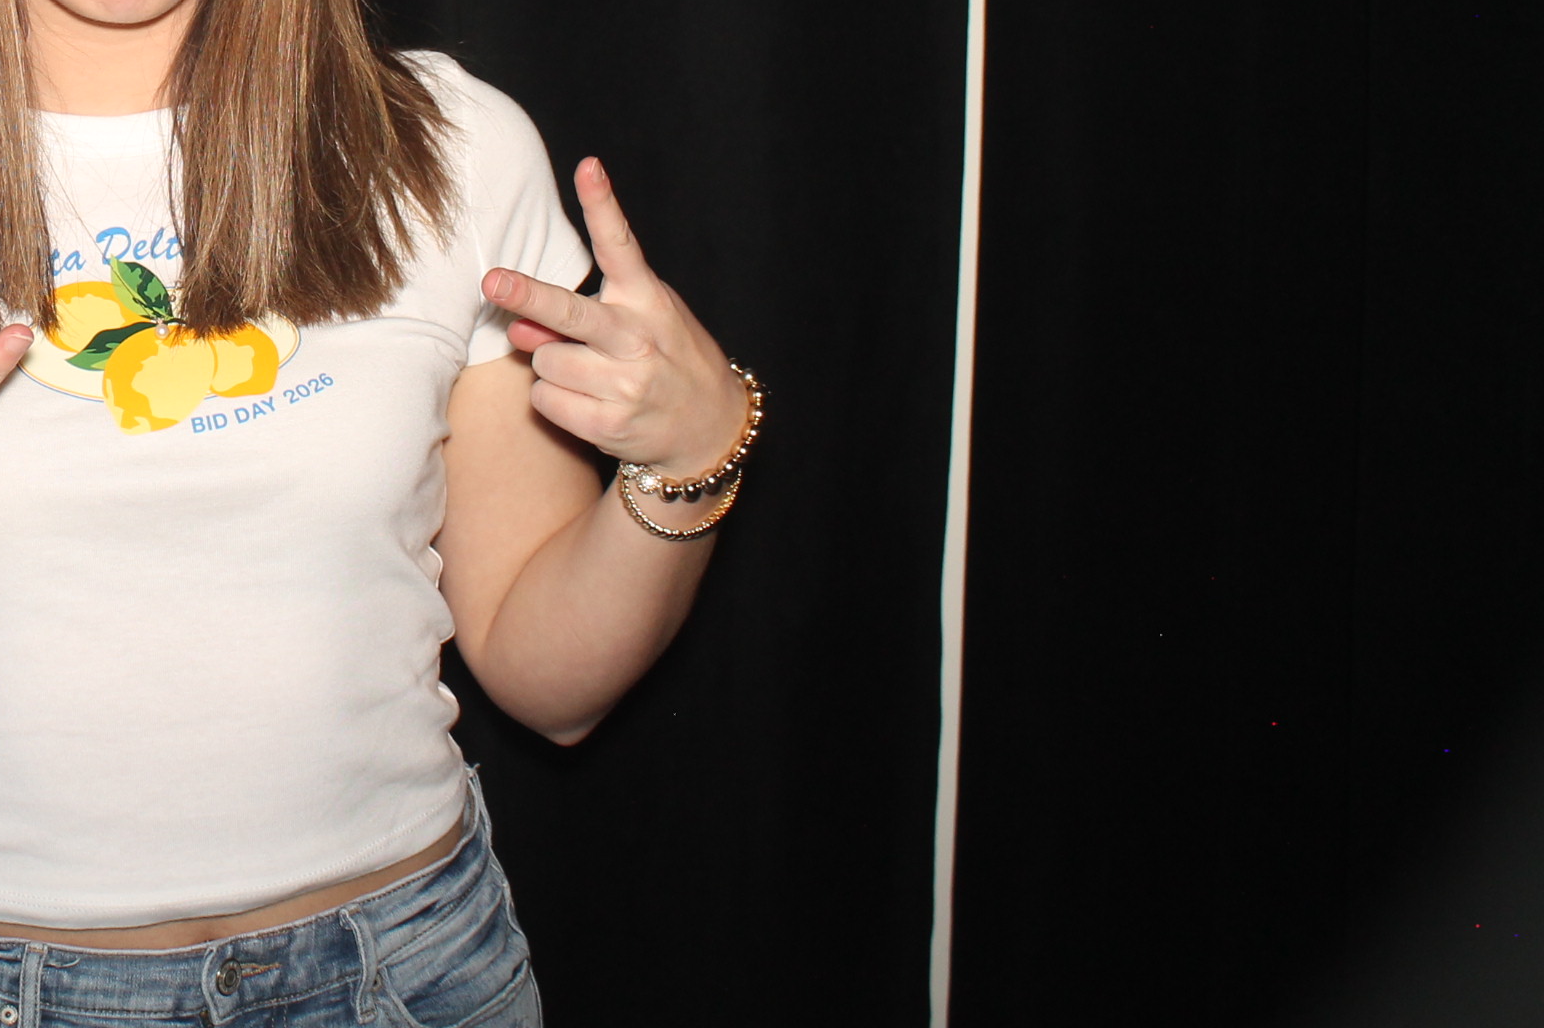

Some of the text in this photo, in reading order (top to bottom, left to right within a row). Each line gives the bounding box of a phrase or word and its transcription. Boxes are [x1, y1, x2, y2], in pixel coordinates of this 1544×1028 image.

[96, 226, 184, 266] Delt
[191, 373, 334, 433] BID DAY 2026
